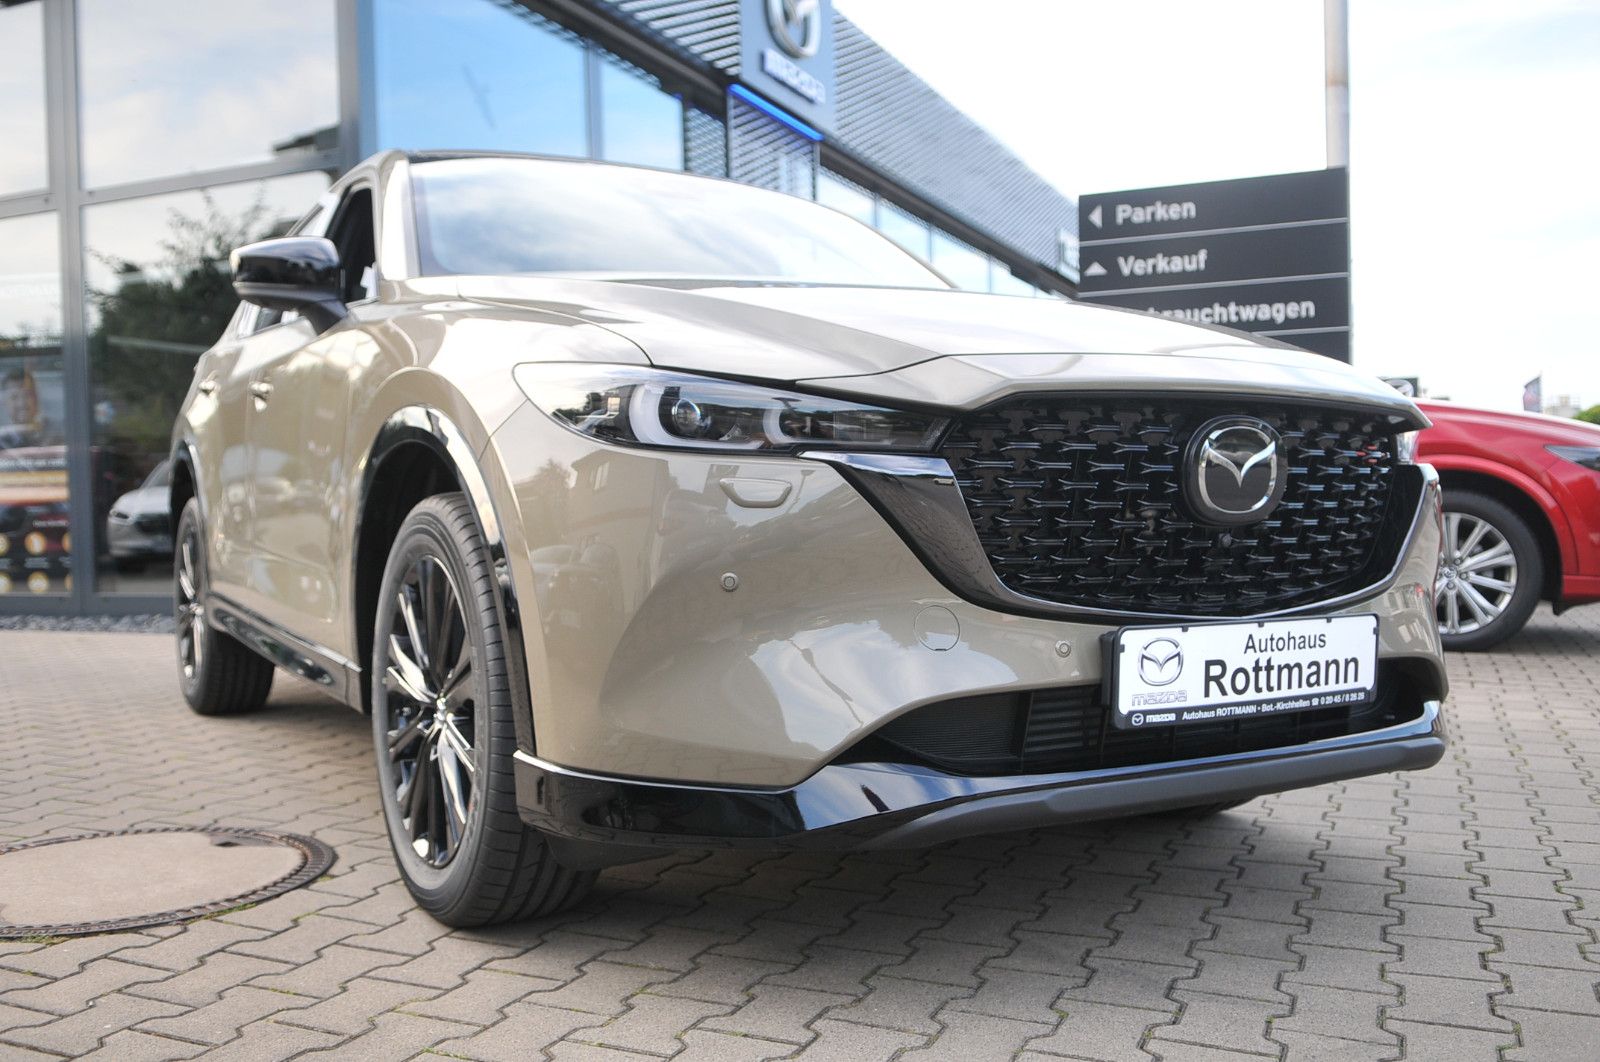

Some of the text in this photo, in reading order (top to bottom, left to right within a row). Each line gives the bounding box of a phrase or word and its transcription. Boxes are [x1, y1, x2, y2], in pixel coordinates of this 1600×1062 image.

[1116, 201, 1196, 225] Parken
[1117, 249, 1208, 277] Verkauf
[1148, 300, 1315, 324] rauchtwagen
[1243, 631, 1327, 654] Autohaus
[1204, 656, 1358, 698] Rottmann
[1131, 689, 1187, 706] mazda
[1182, 710, 1215, 720] Autohaus
[1216, 704, 1257, 717] ROTTMANN
